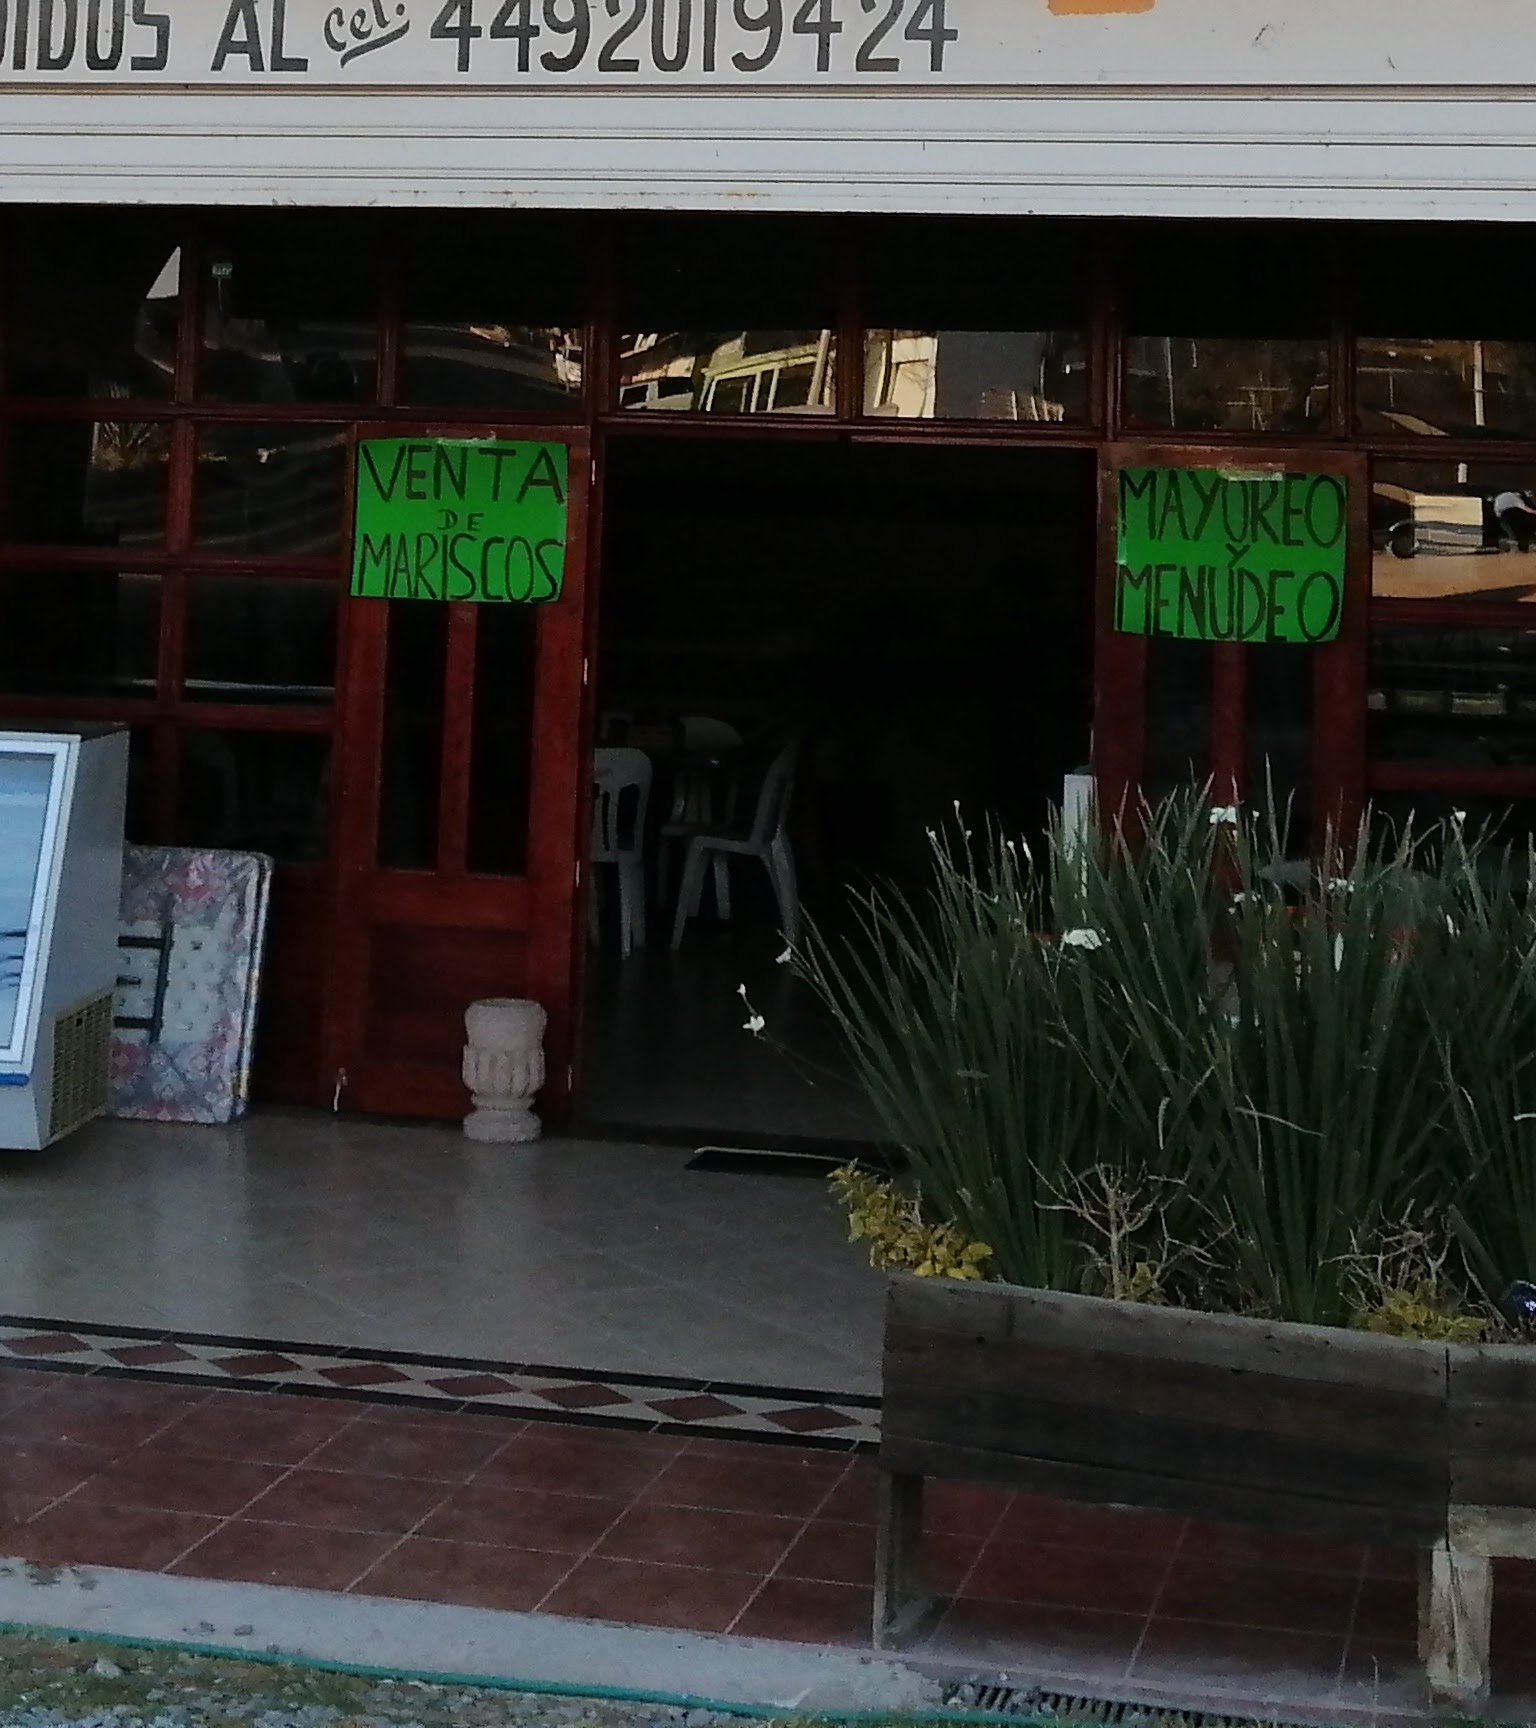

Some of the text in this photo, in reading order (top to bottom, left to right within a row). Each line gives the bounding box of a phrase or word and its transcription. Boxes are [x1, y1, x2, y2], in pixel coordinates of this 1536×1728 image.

[361, 443, 564, 503] VENTA
[437, 509, 484, 531] DE
[1119, 469, 1345, 548] MAYOREO
[358, 532, 563, 602] MARISCOS
[1226, 543, 1250, 566] Y
[1117, 564, 1340, 641] MENUDEO
